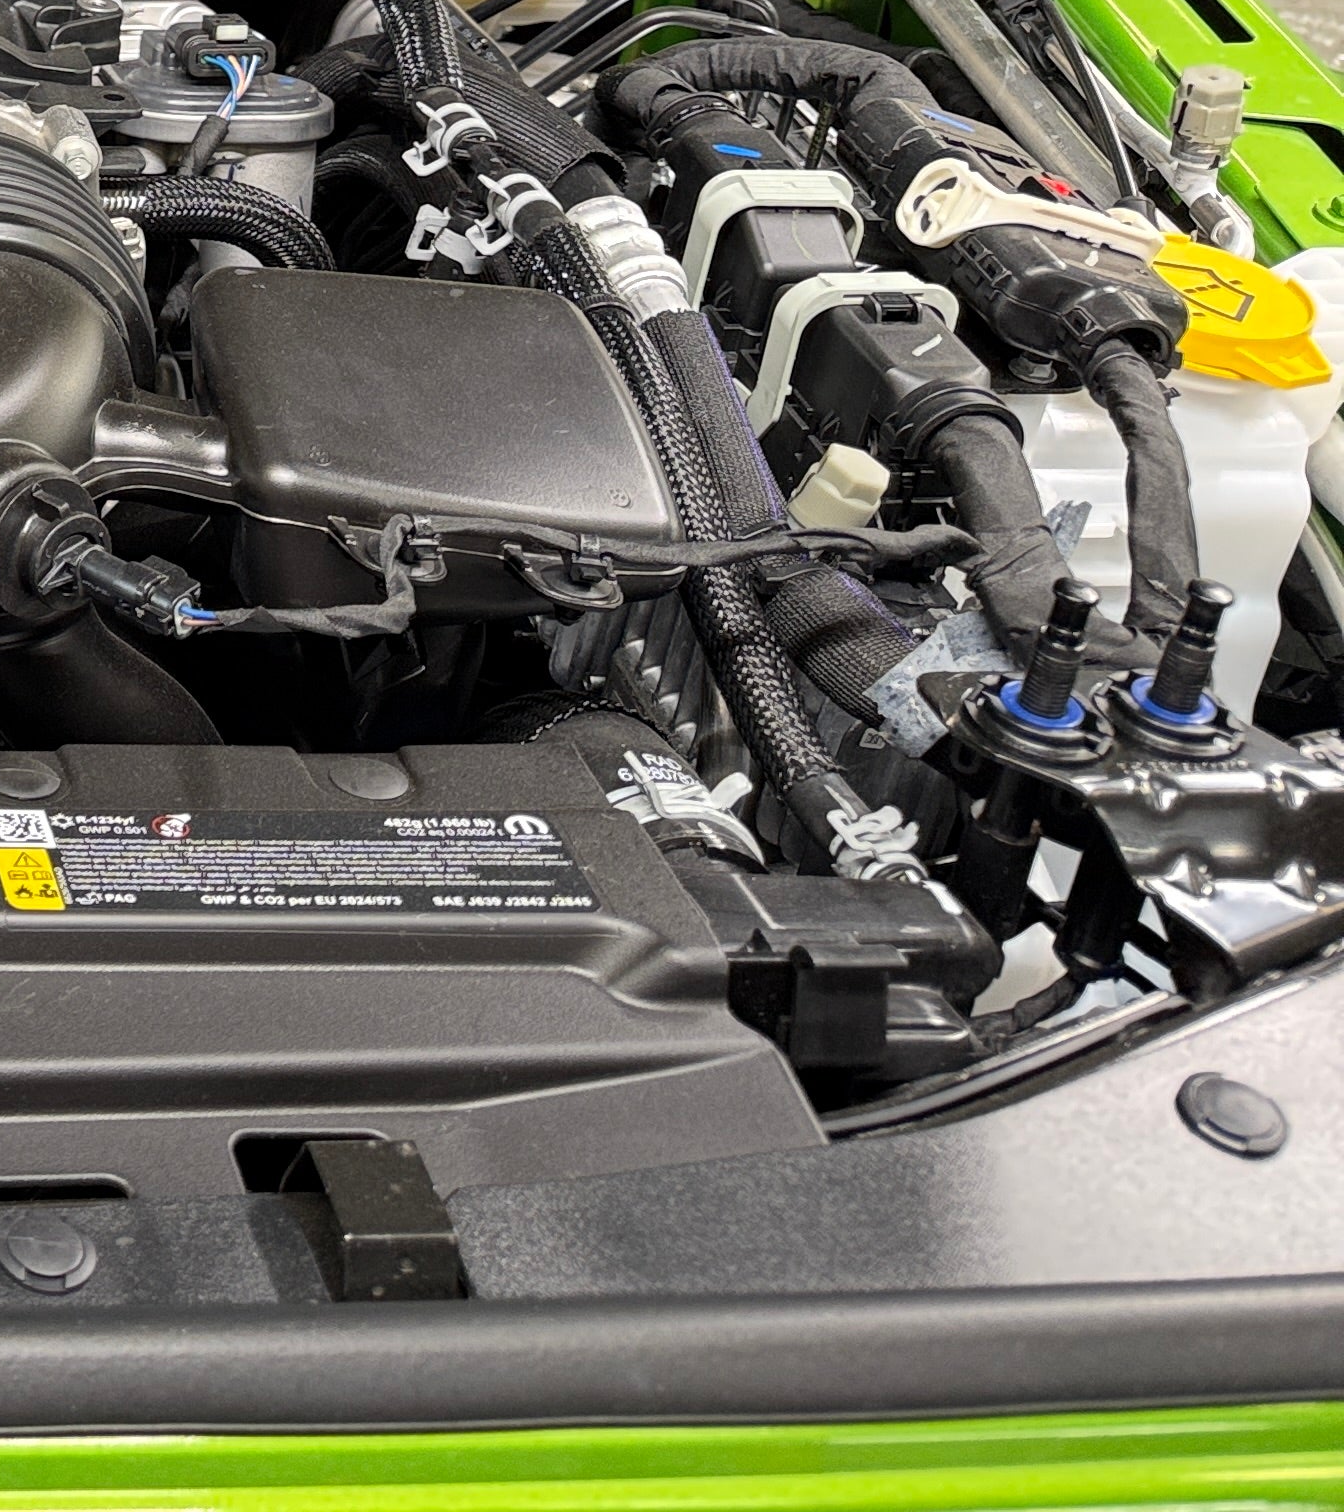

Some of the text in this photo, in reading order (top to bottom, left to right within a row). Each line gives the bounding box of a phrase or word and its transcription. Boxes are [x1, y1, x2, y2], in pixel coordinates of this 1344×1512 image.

[641, 753, 682, 771] RAD
[472, 817, 496, 829] lb)
[78, 825, 111, 835] GWP
[396, 828, 426, 837] CO2
[104, 893, 138, 904] PAG
[200, 894, 237, 905] GWP
[239, 895, 252, 905] &
[253, 894, 287, 905] CO2
[288, 896, 313, 907] per
[314, 895, 337, 905] EU
[432, 896, 465, 906] SAE
